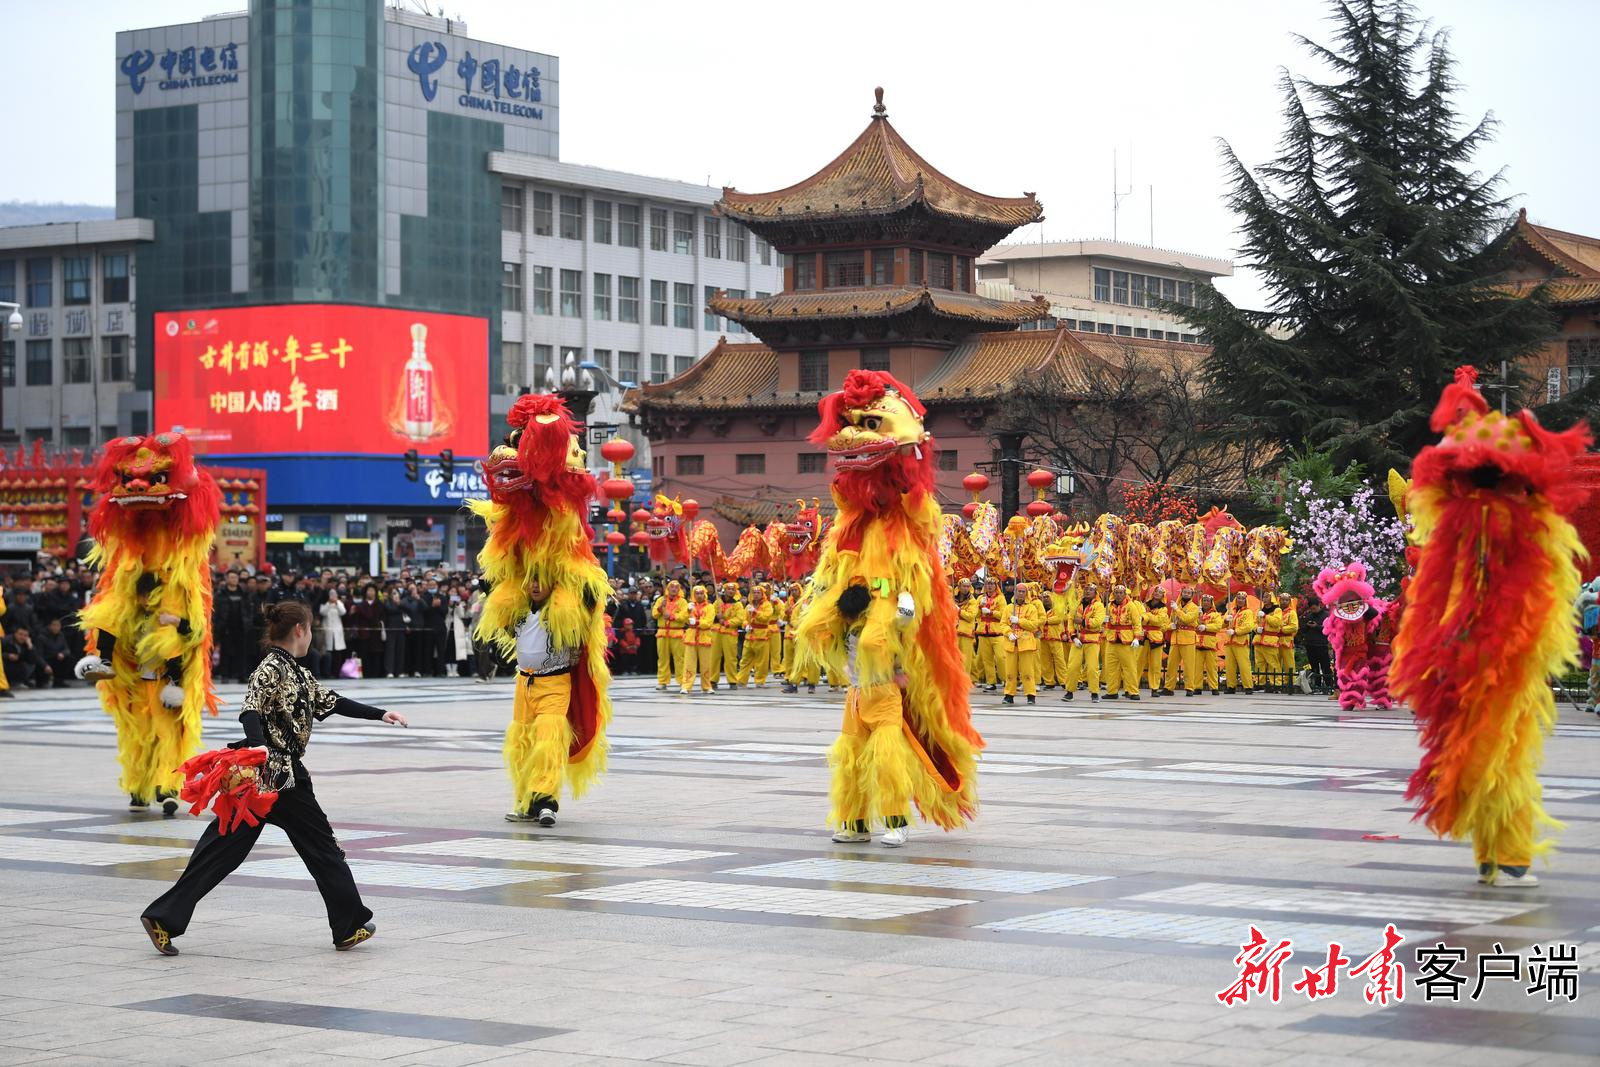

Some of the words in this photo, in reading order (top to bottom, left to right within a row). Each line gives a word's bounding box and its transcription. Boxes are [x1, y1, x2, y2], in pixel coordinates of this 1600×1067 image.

[159, 42, 239, 80] 中国电信
[457, 52, 542, 103] 中国电信
[210, 376, 338, 431] 中国人的年酒
